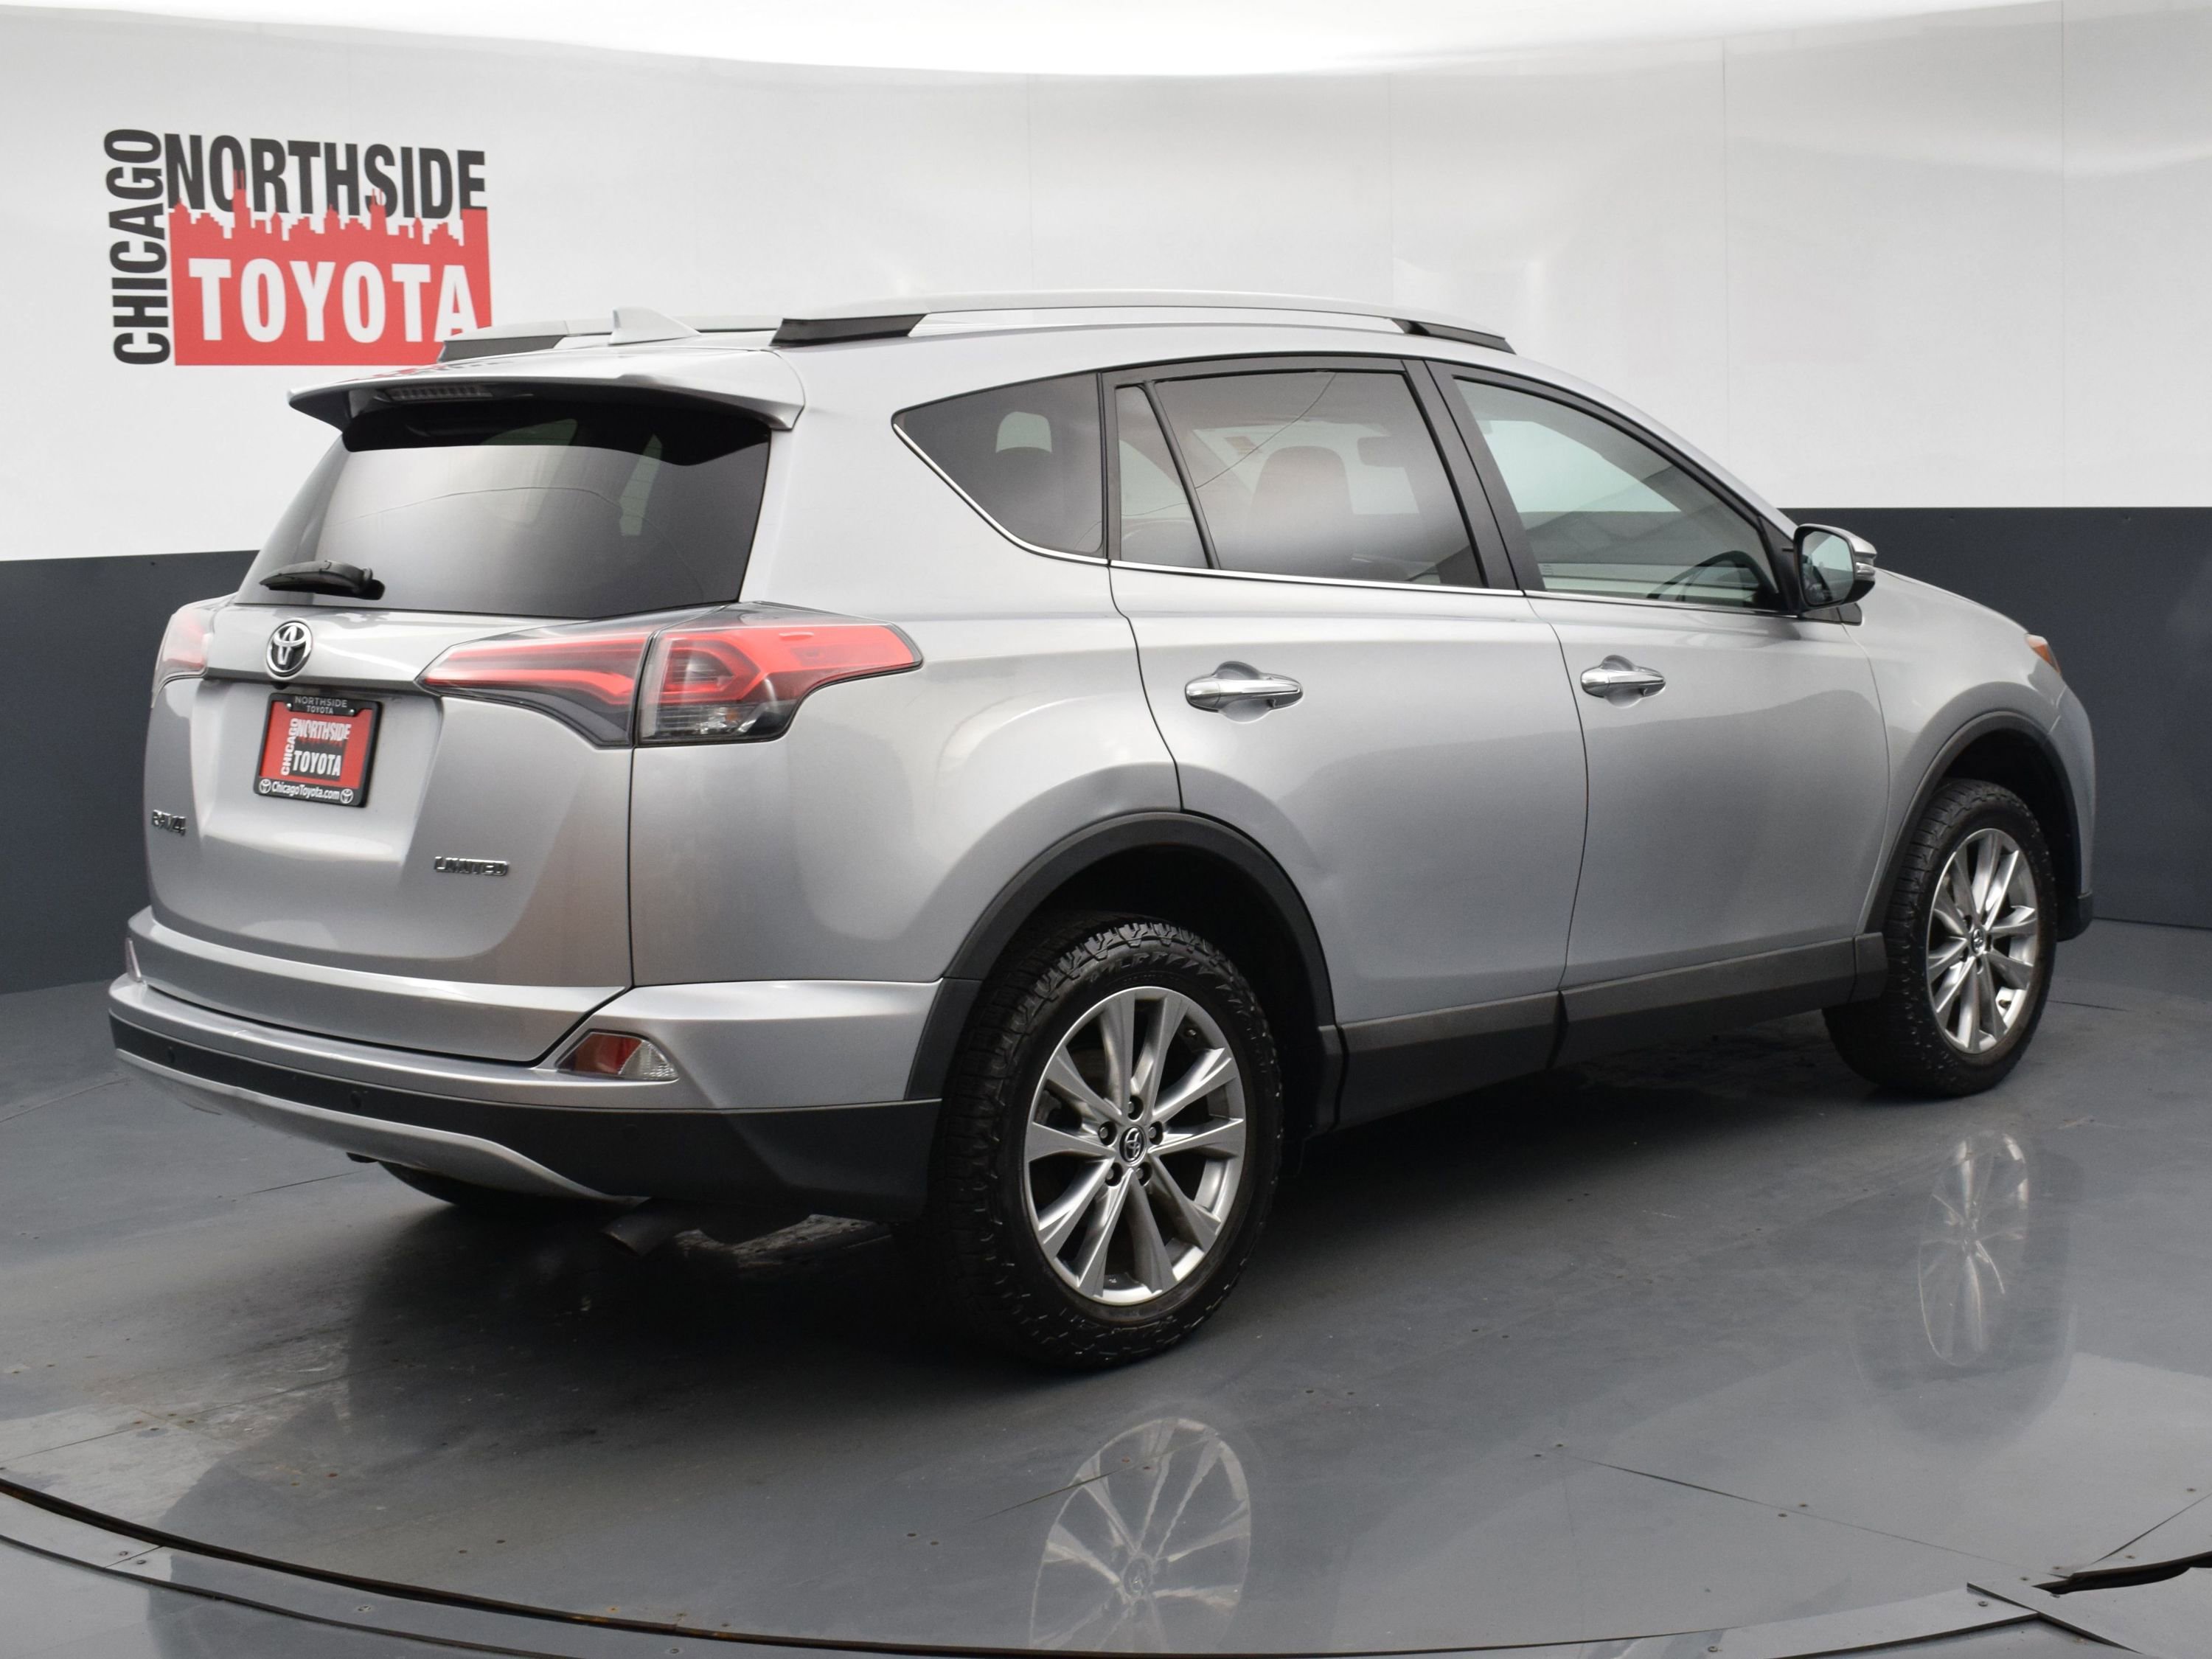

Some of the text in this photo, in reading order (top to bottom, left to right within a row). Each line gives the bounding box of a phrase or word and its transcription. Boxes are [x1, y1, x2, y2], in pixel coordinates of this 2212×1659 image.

[164, 133, 487, 220] NORTHSIDE
[103, 128, 171, 365] CHICAGO
[188, 257, 479, 343] TOYOTA
[295, 696, 348, 708] NORTHSIDE
[307, 705, 333, 714] TOYOTA
[295, 718, 352, 742] NORTHSIDE
[281, 717, 299, 776] CHICAGO
[293, 750, 342, 776] TOYOTA
[271, 781, 340, 800] ChicagoToyota.com
[153, 809, 187, 836] RAV4
[434, 856, 509, 876] LIMITED
